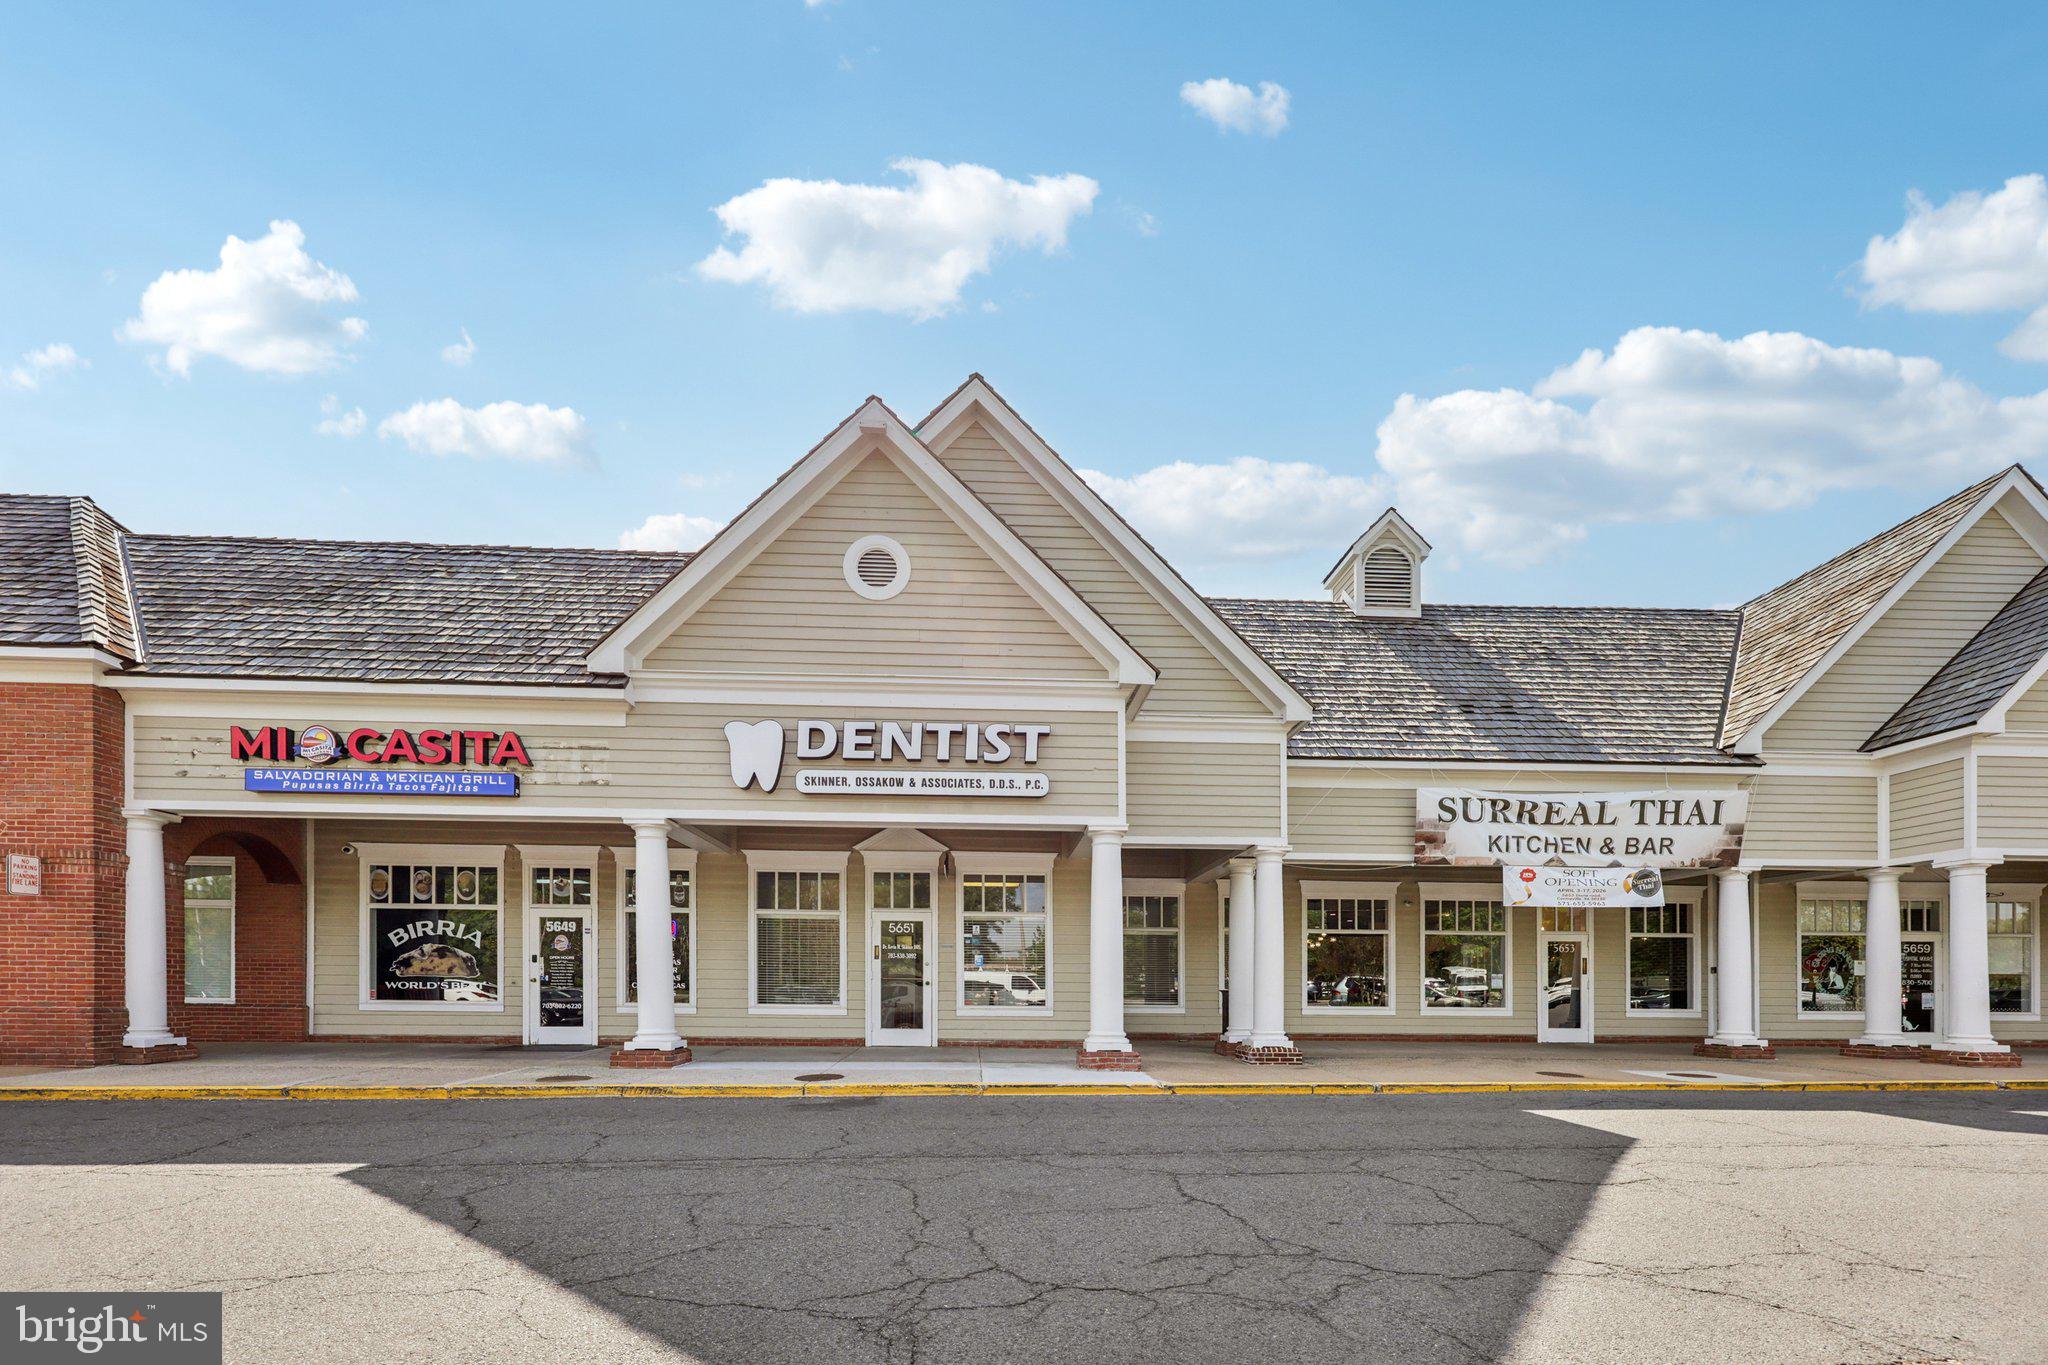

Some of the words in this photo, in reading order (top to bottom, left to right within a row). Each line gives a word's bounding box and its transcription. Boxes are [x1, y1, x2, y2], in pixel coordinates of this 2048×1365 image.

[230, 725, 290, 761] MI
[346, 728, 531, 766] CASITA
[796, 720, 1051, 763] DENTIST
[253, 770, 363, 782] SALVADORIAN
[369, 773, 380, 782] &
[386, 773, 455, 784] MEXICAN
[461, 774, 507, 785] GRILL
[804, 776, 851, 787] SKINNER,
[855, 776, 904, 788] OSSAKOW
[909, 777, 916, 788] &
[921, 778, 985, 790] ASSOCIATES,
[1025, 780, 1044, 790] P.C.
[282, 781, 340, 790] Pupusas
[344, 781, 384, 790] Birria
[388, 782, 426, 791] Tacos
[430, 783, 479, 793] Fajitas
[1438, 796, 1618, 826] SURREAL
[1630, 799, 1726, 826] THAI
[1488, 835, 1591, 854] KITCHEN
[1600, 837, 1616, 855] &
[1625, 837, 1675, 855] BAR
[1562, 869, 1598, 877] SOFT
[1544, 877, 1618, 887] OPENING
[546, 921, 577, 932] 5649
[888, 923, 914, 933] 5651
[387, 919, 482, 949] BIRRIA
[1553, 943, 1576, 953] 5653
[1903, 944, 1931, 953] 5659
[385, 981, 448, 989] WORLD'S
